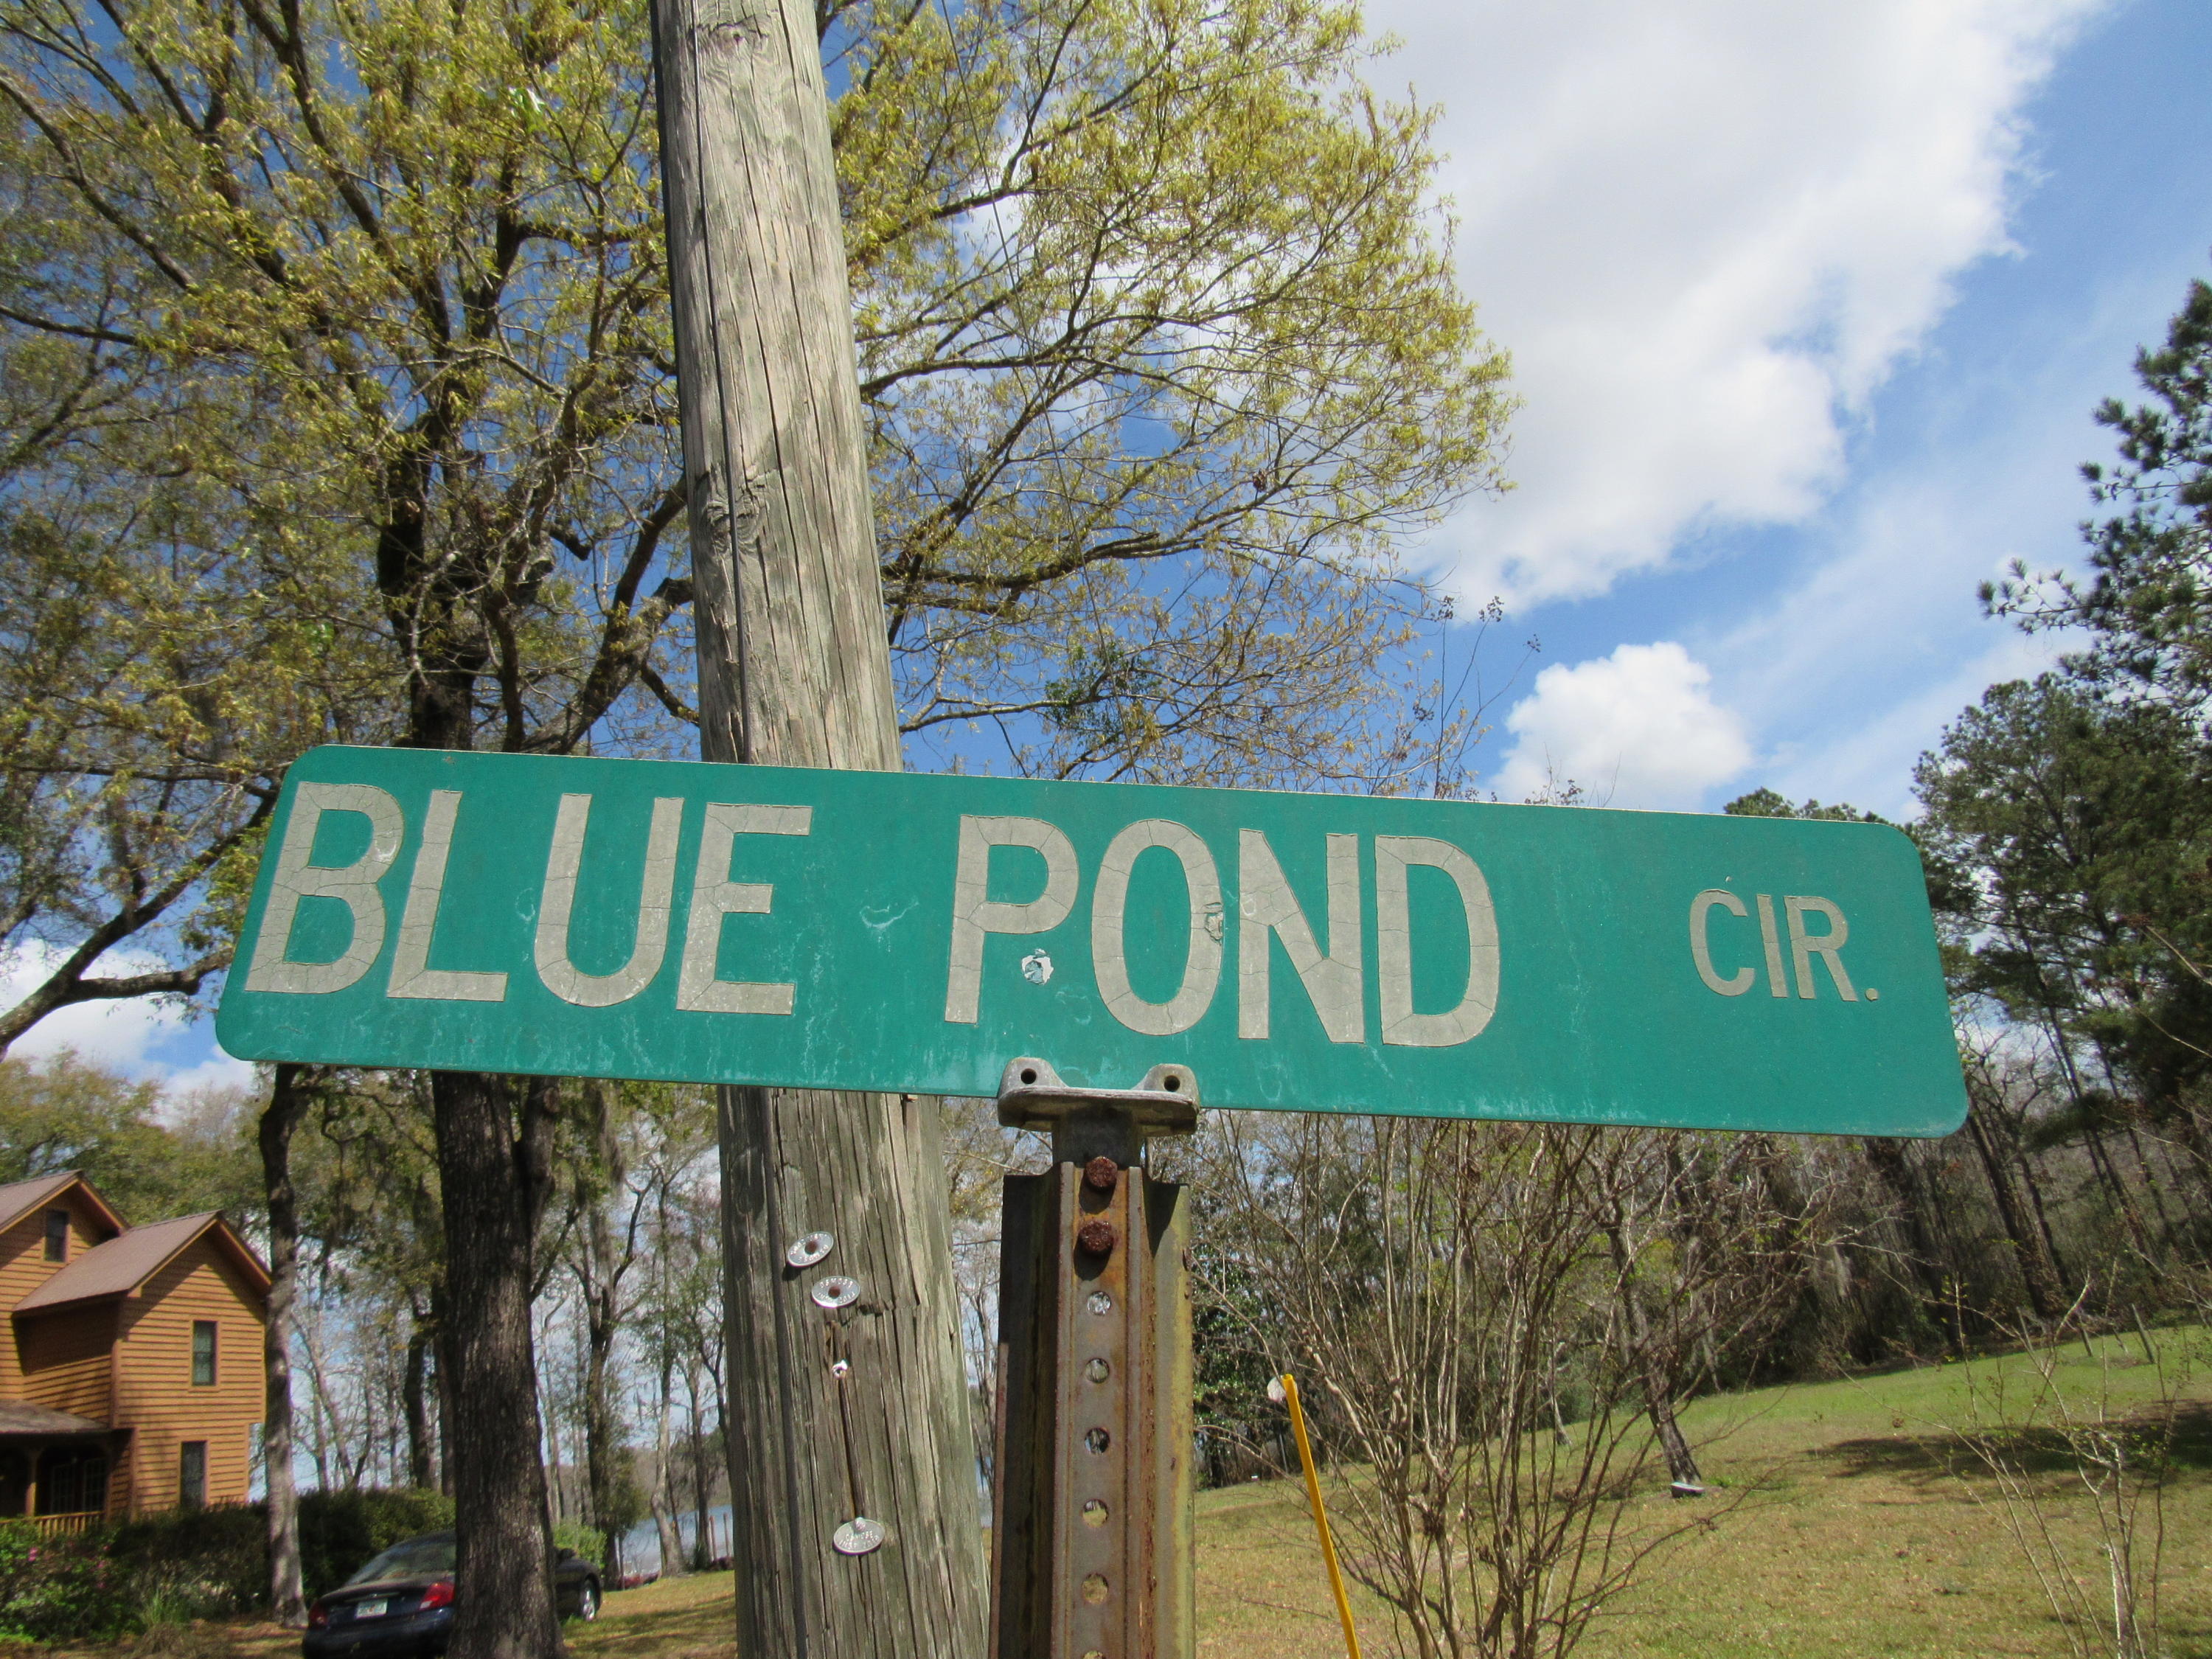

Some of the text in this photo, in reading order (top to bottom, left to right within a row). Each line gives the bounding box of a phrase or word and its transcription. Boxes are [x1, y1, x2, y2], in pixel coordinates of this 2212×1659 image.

[244, 782, 1879, 1048] BLUE POND CIR.
